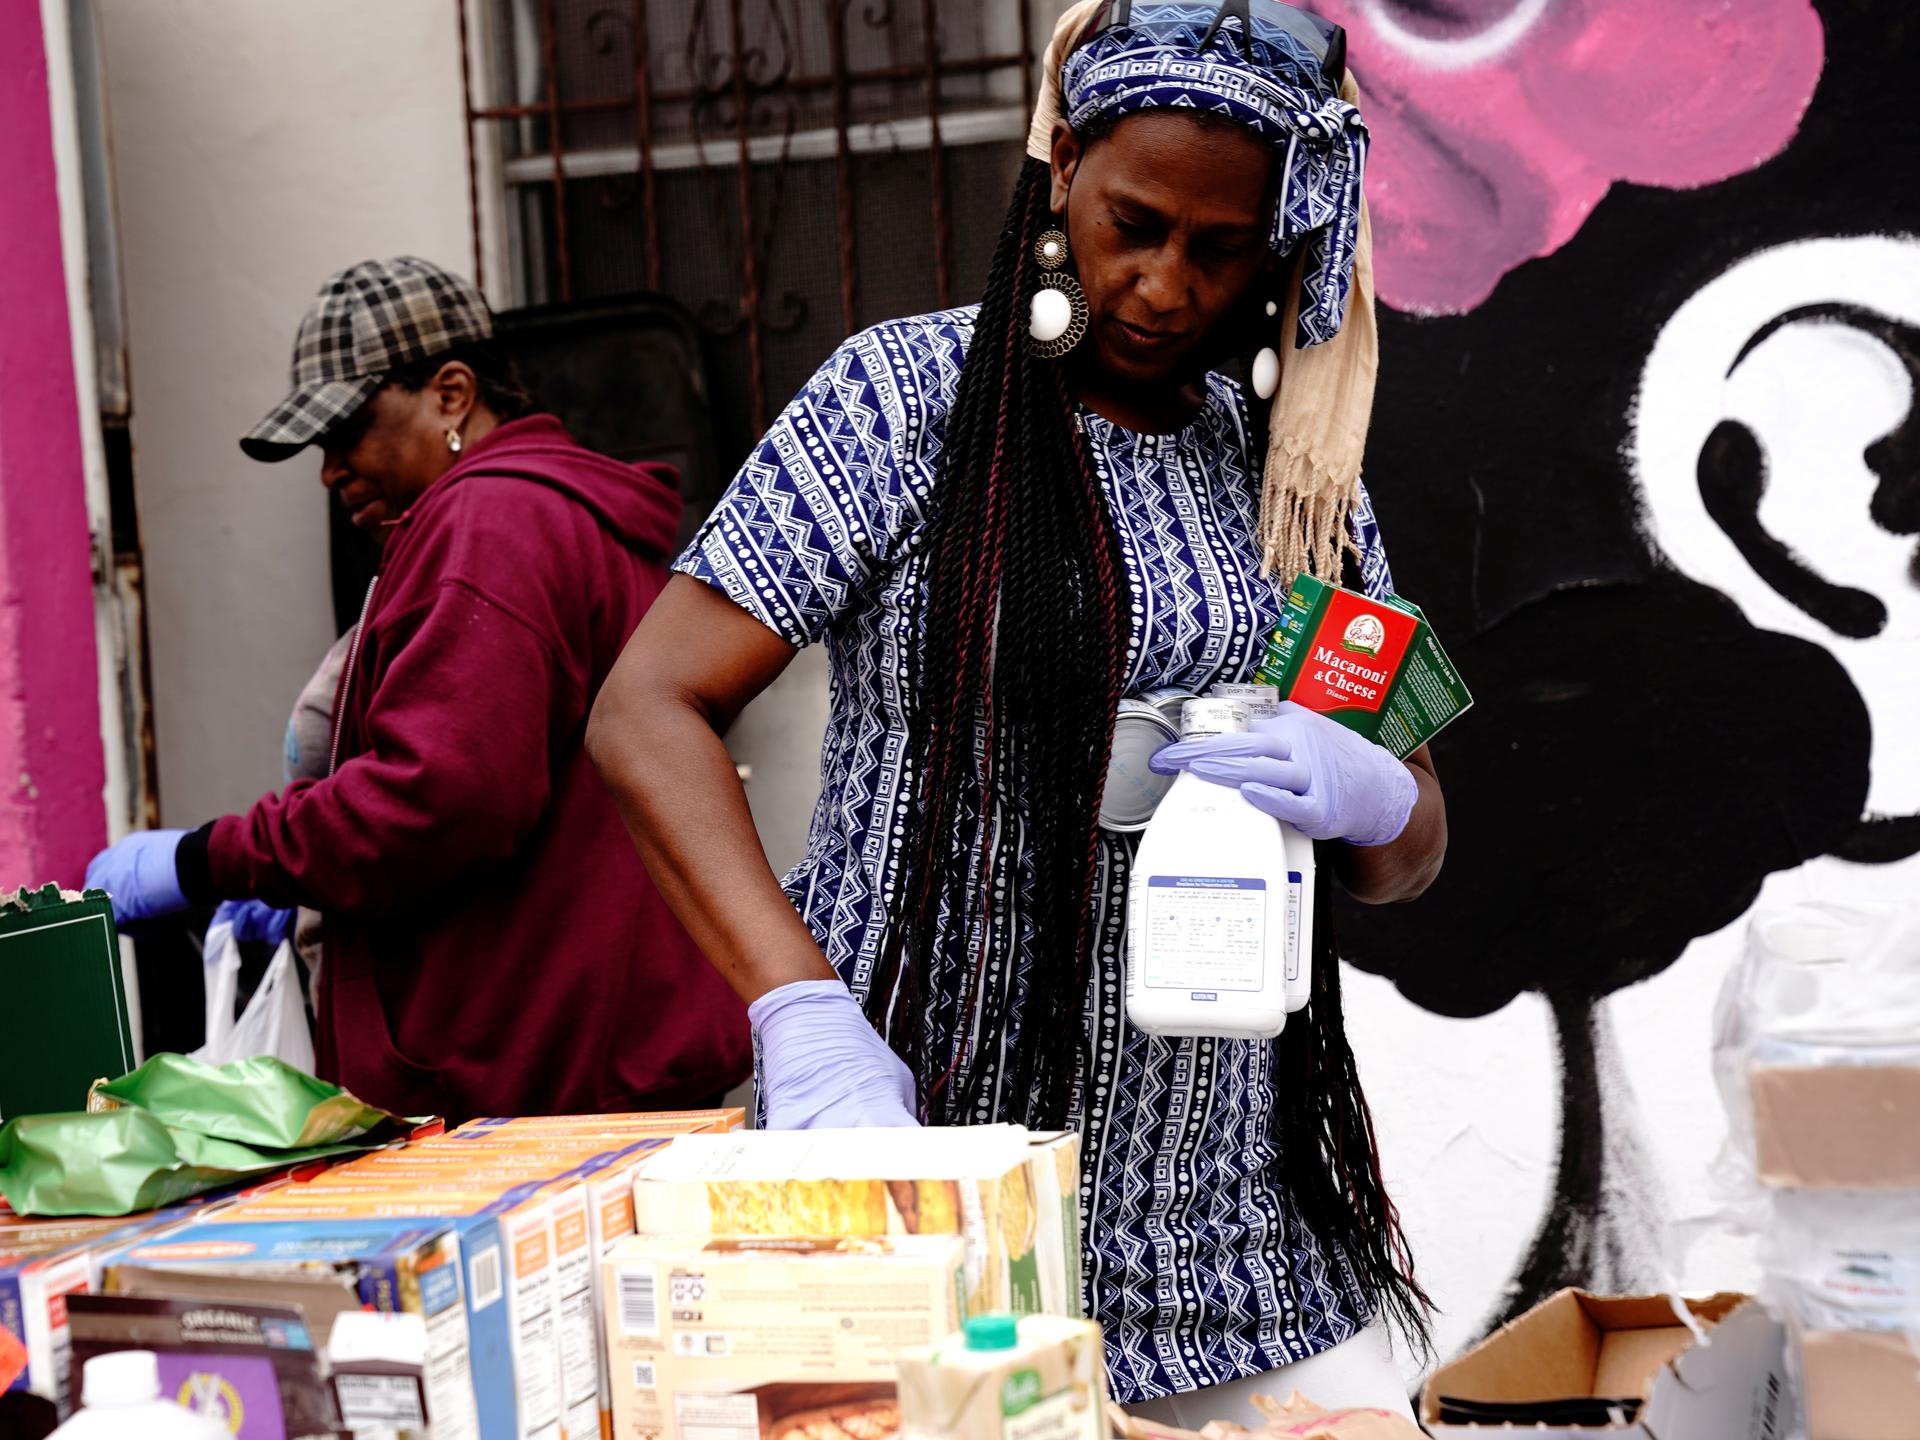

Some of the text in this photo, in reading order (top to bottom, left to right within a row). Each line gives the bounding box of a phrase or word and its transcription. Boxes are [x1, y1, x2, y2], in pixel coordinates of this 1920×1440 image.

[1314, 646, 1388, 685] Macaroni
[1326, 688, 1350, 702] Dinner
[182, 1309, 257, 1332] ORGANIC
